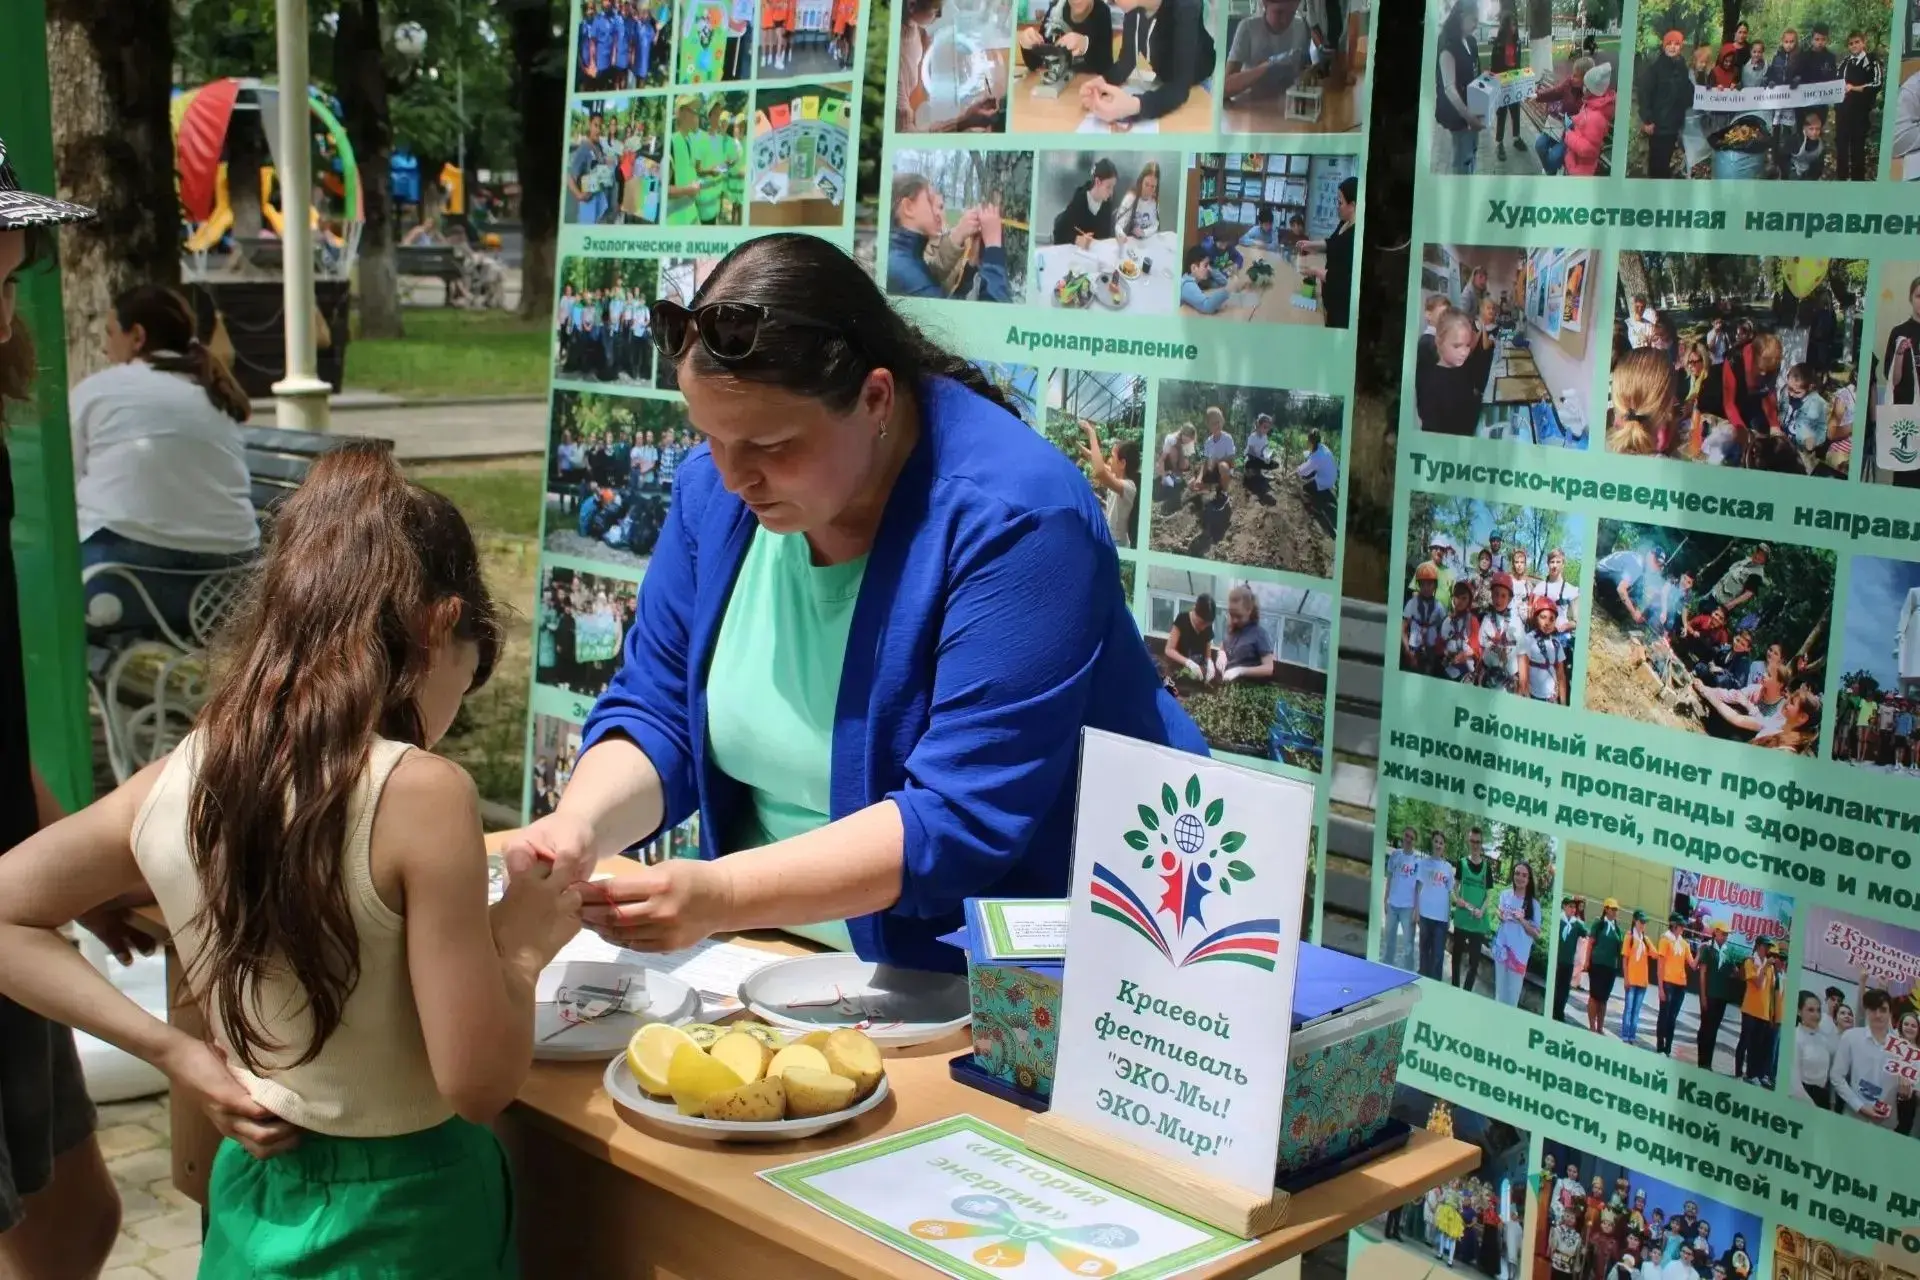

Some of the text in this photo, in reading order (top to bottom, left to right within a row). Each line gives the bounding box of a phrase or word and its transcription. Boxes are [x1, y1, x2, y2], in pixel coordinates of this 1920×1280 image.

[583, 236, 682, 252] Экологические
[686, 241, 729, 256] акции
[1487, 200, 1920, 238] Художественная направлен
[1006, 326, 1198, 360] Агронаправление
[1410, 452, 1774, 521] Туристско-краеведческая
[1390, 730, 1911, 870] наркомании, пропаганды здорового
[1454, 706, 1920, 834] Районный кабинет профилакти
[1382, 759, 1465, 795] жизни
[1472, 782, 1548, 817] среди
[1555, 803, 1644, 845] детей,
[1653, 828, 1826, 887] подростков
[1837, 873, 1857, 896] и
[1116, 979, 1230, 1039] Краевой
[1095, 1012, 1248, 1085] фестиваль
[1108, 1051, 1231, 1119] "ЭКО-Мы!
[1413, 1020, 1720, 1148] Духовно-нравственной
[1730, 1135, 1878, 1203] культуры
[1528, 1027, 1803, 1140] Районный Кабинет
[1096, 1088, 1233, 1156] ЭКО-Мир!"
[926, 1156, 1068, 1220] энергии»
[966, 1143, 1109, 1206] «История
[1616, 1129, 1771, 1199] родителей
[1780, 1188, 1798, 1211] и
[1808, 1198, 1920, 1253] педаго
